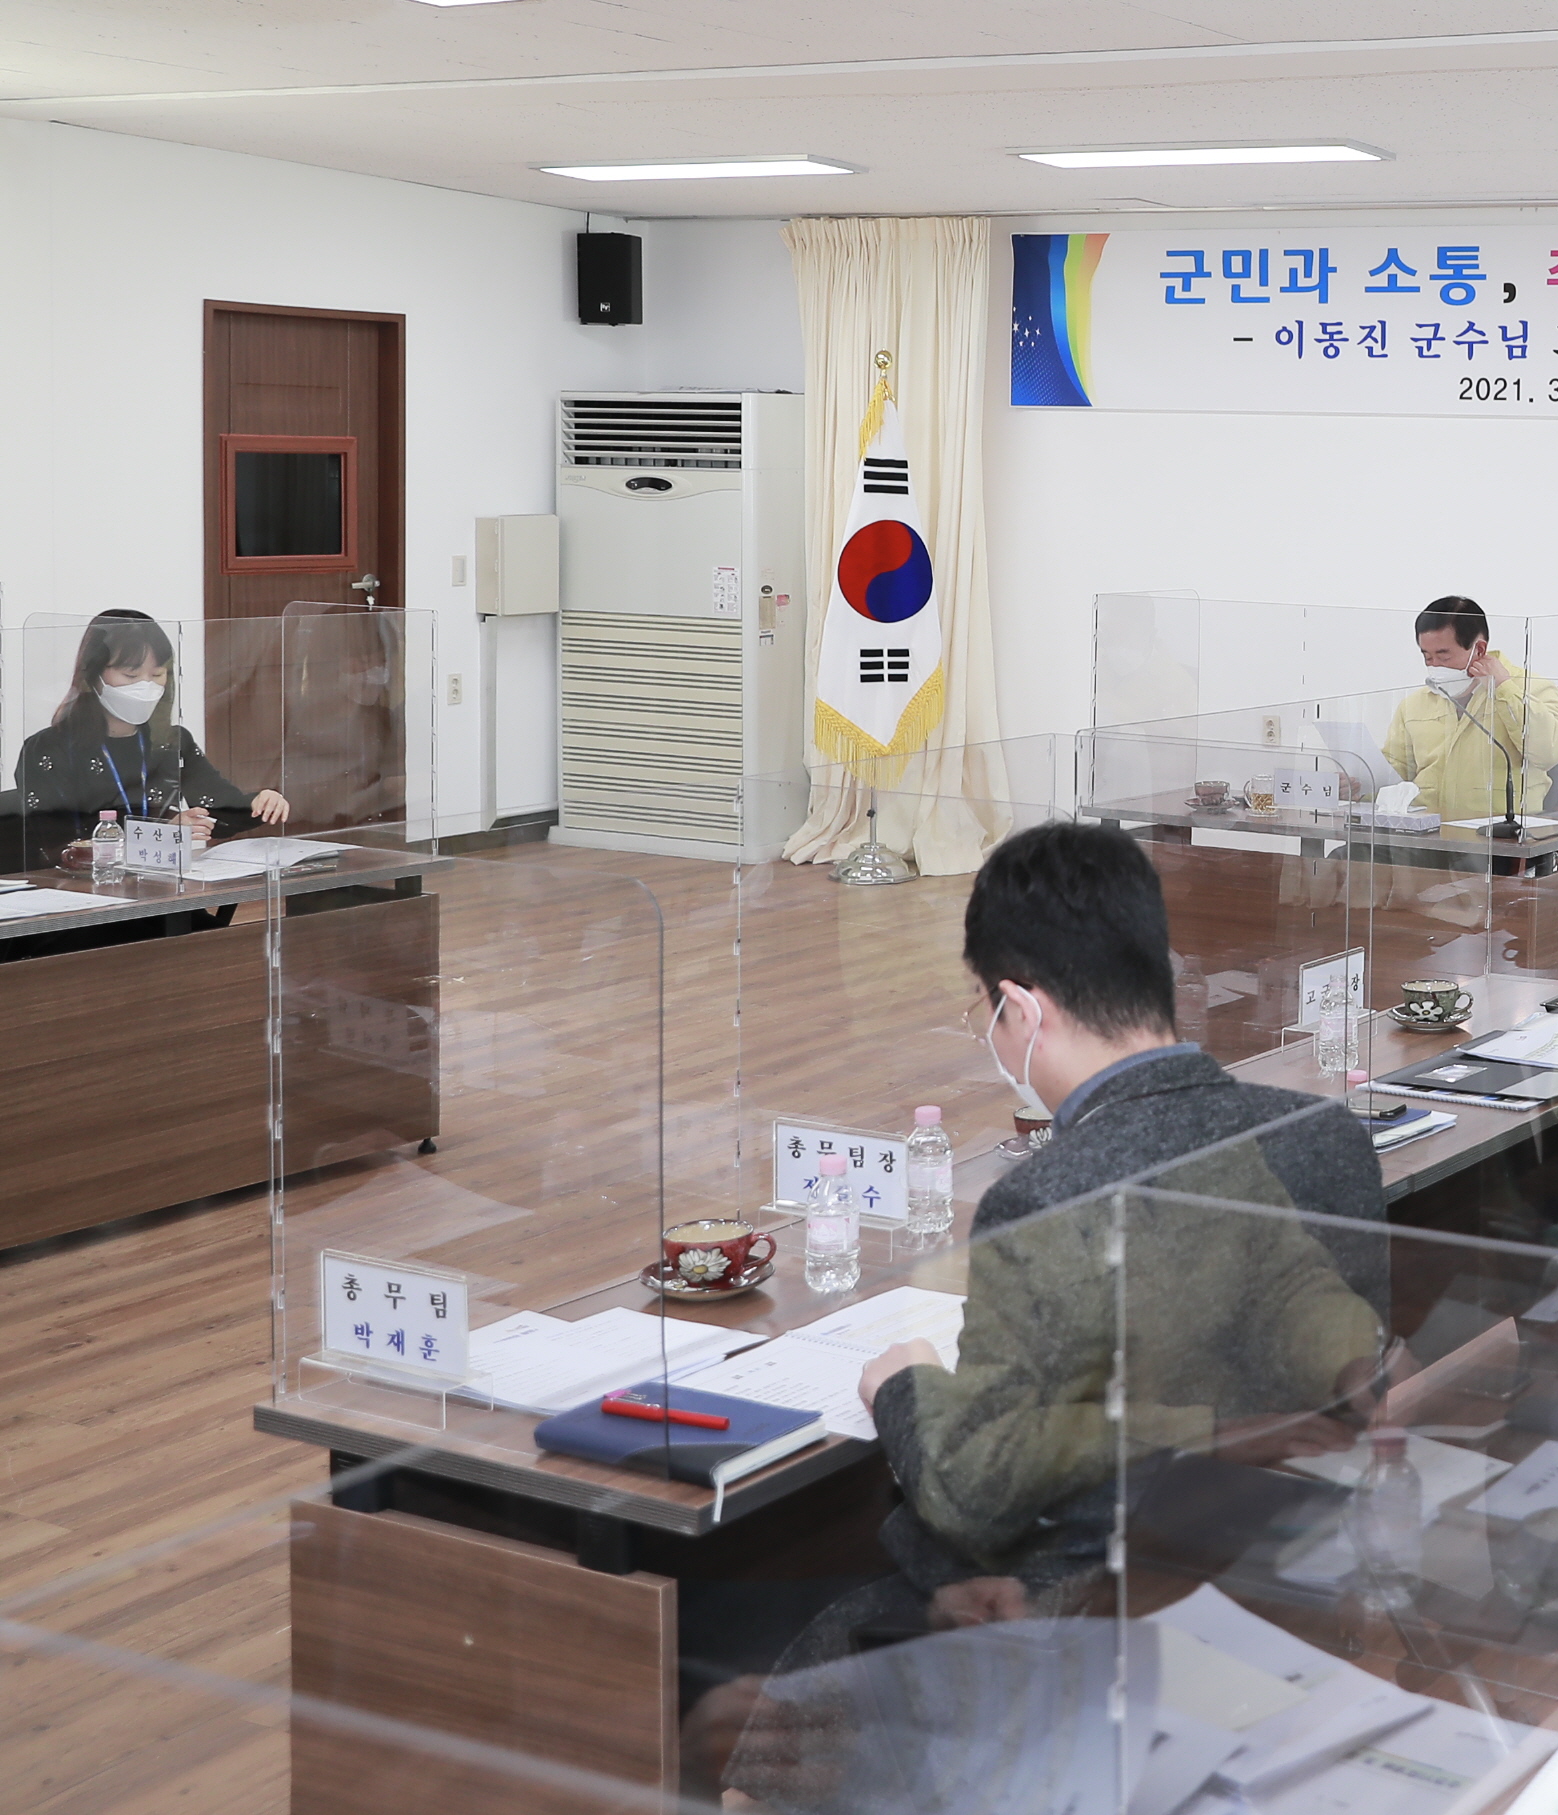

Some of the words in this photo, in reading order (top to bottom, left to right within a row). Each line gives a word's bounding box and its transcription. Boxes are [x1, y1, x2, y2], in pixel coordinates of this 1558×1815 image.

[1160, 247, 1338, 305] 군민과
[1365, 246, 1517, 306] 소통,
[1274, 319, 1389, 360] 이동진
[1410, 319, 1529, 361] 군수님
[1458, 376, 1534, 403] 2021.
